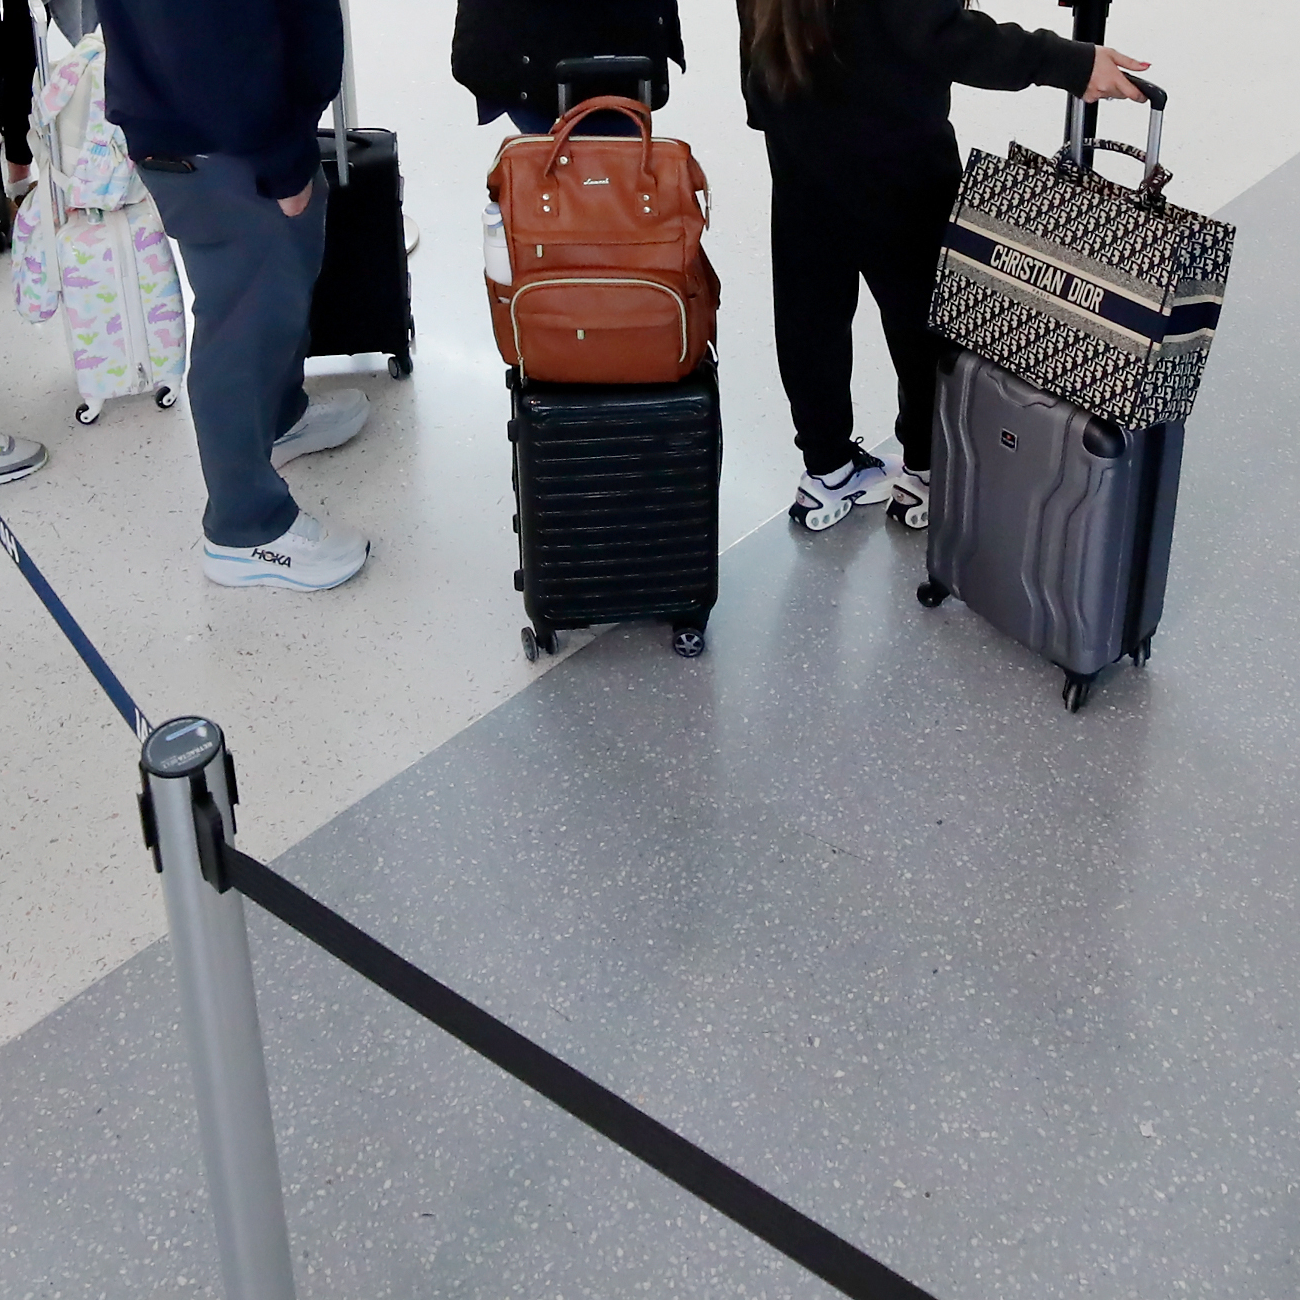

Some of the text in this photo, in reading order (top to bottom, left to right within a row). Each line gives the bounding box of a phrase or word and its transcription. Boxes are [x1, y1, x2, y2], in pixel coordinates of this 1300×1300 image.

[990, 244, 1105, 313] CHRISTIAN DIOR
[250, 547, 292, 568] HOKA
[134, 707, 153, 744] IA
